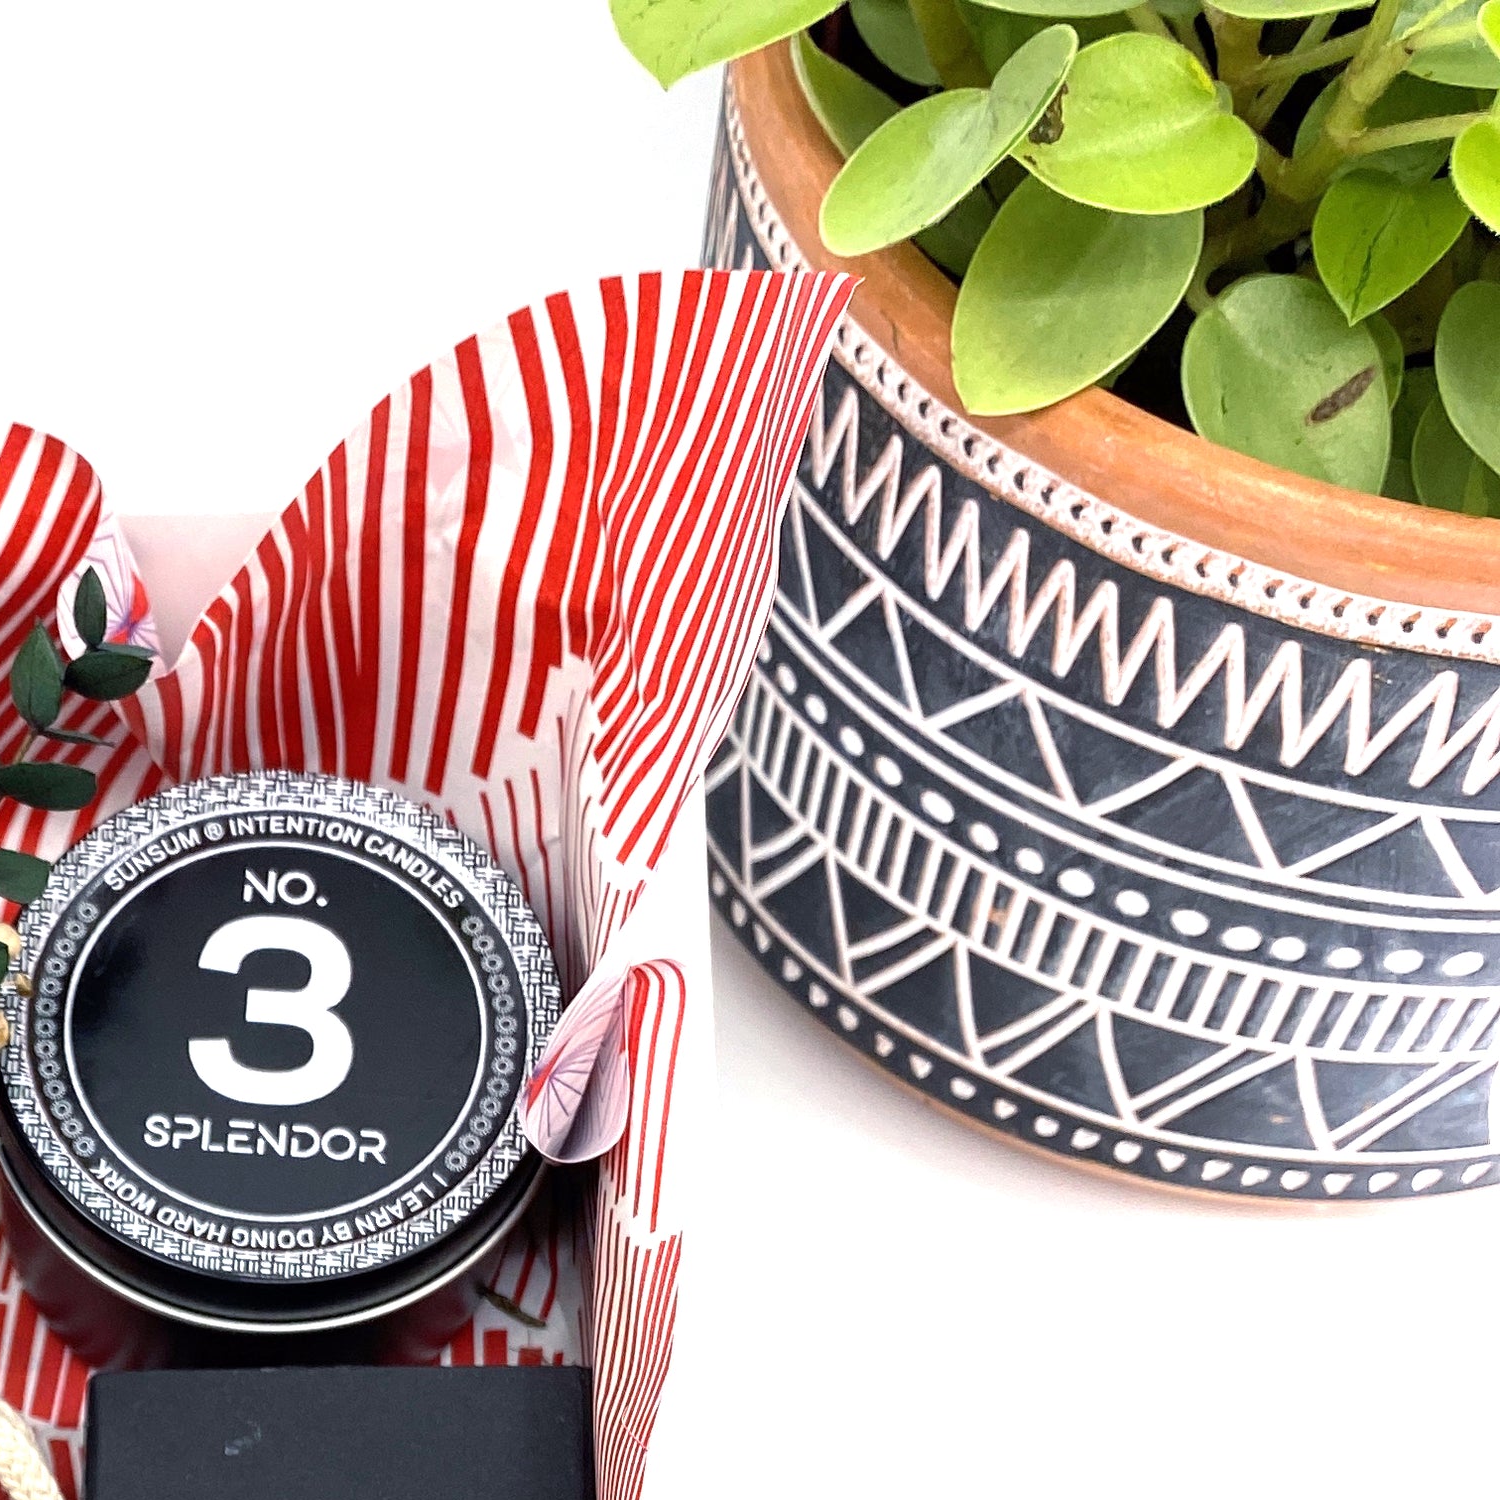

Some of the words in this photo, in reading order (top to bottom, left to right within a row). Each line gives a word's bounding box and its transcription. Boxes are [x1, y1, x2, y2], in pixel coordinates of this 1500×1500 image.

[105, 828, 202, 893] SUNSUM
[229, 815, 363, 844] INTENTION
[364, 835, 465, 909] CANDLES
[242, 868, 328, 907] NO.
[188, 916, 354, 1106] 3
[144, 1113, 387, 1165] SPLENDOR
[89, 1159, 157, 1212] WORK
[356, 1181, 434, 1235] LEARN
[155, 1207, 228, 1243] HARD
[232, 1229, 314, 1249] DOING
[320, 1219, 354, 1245] BY
